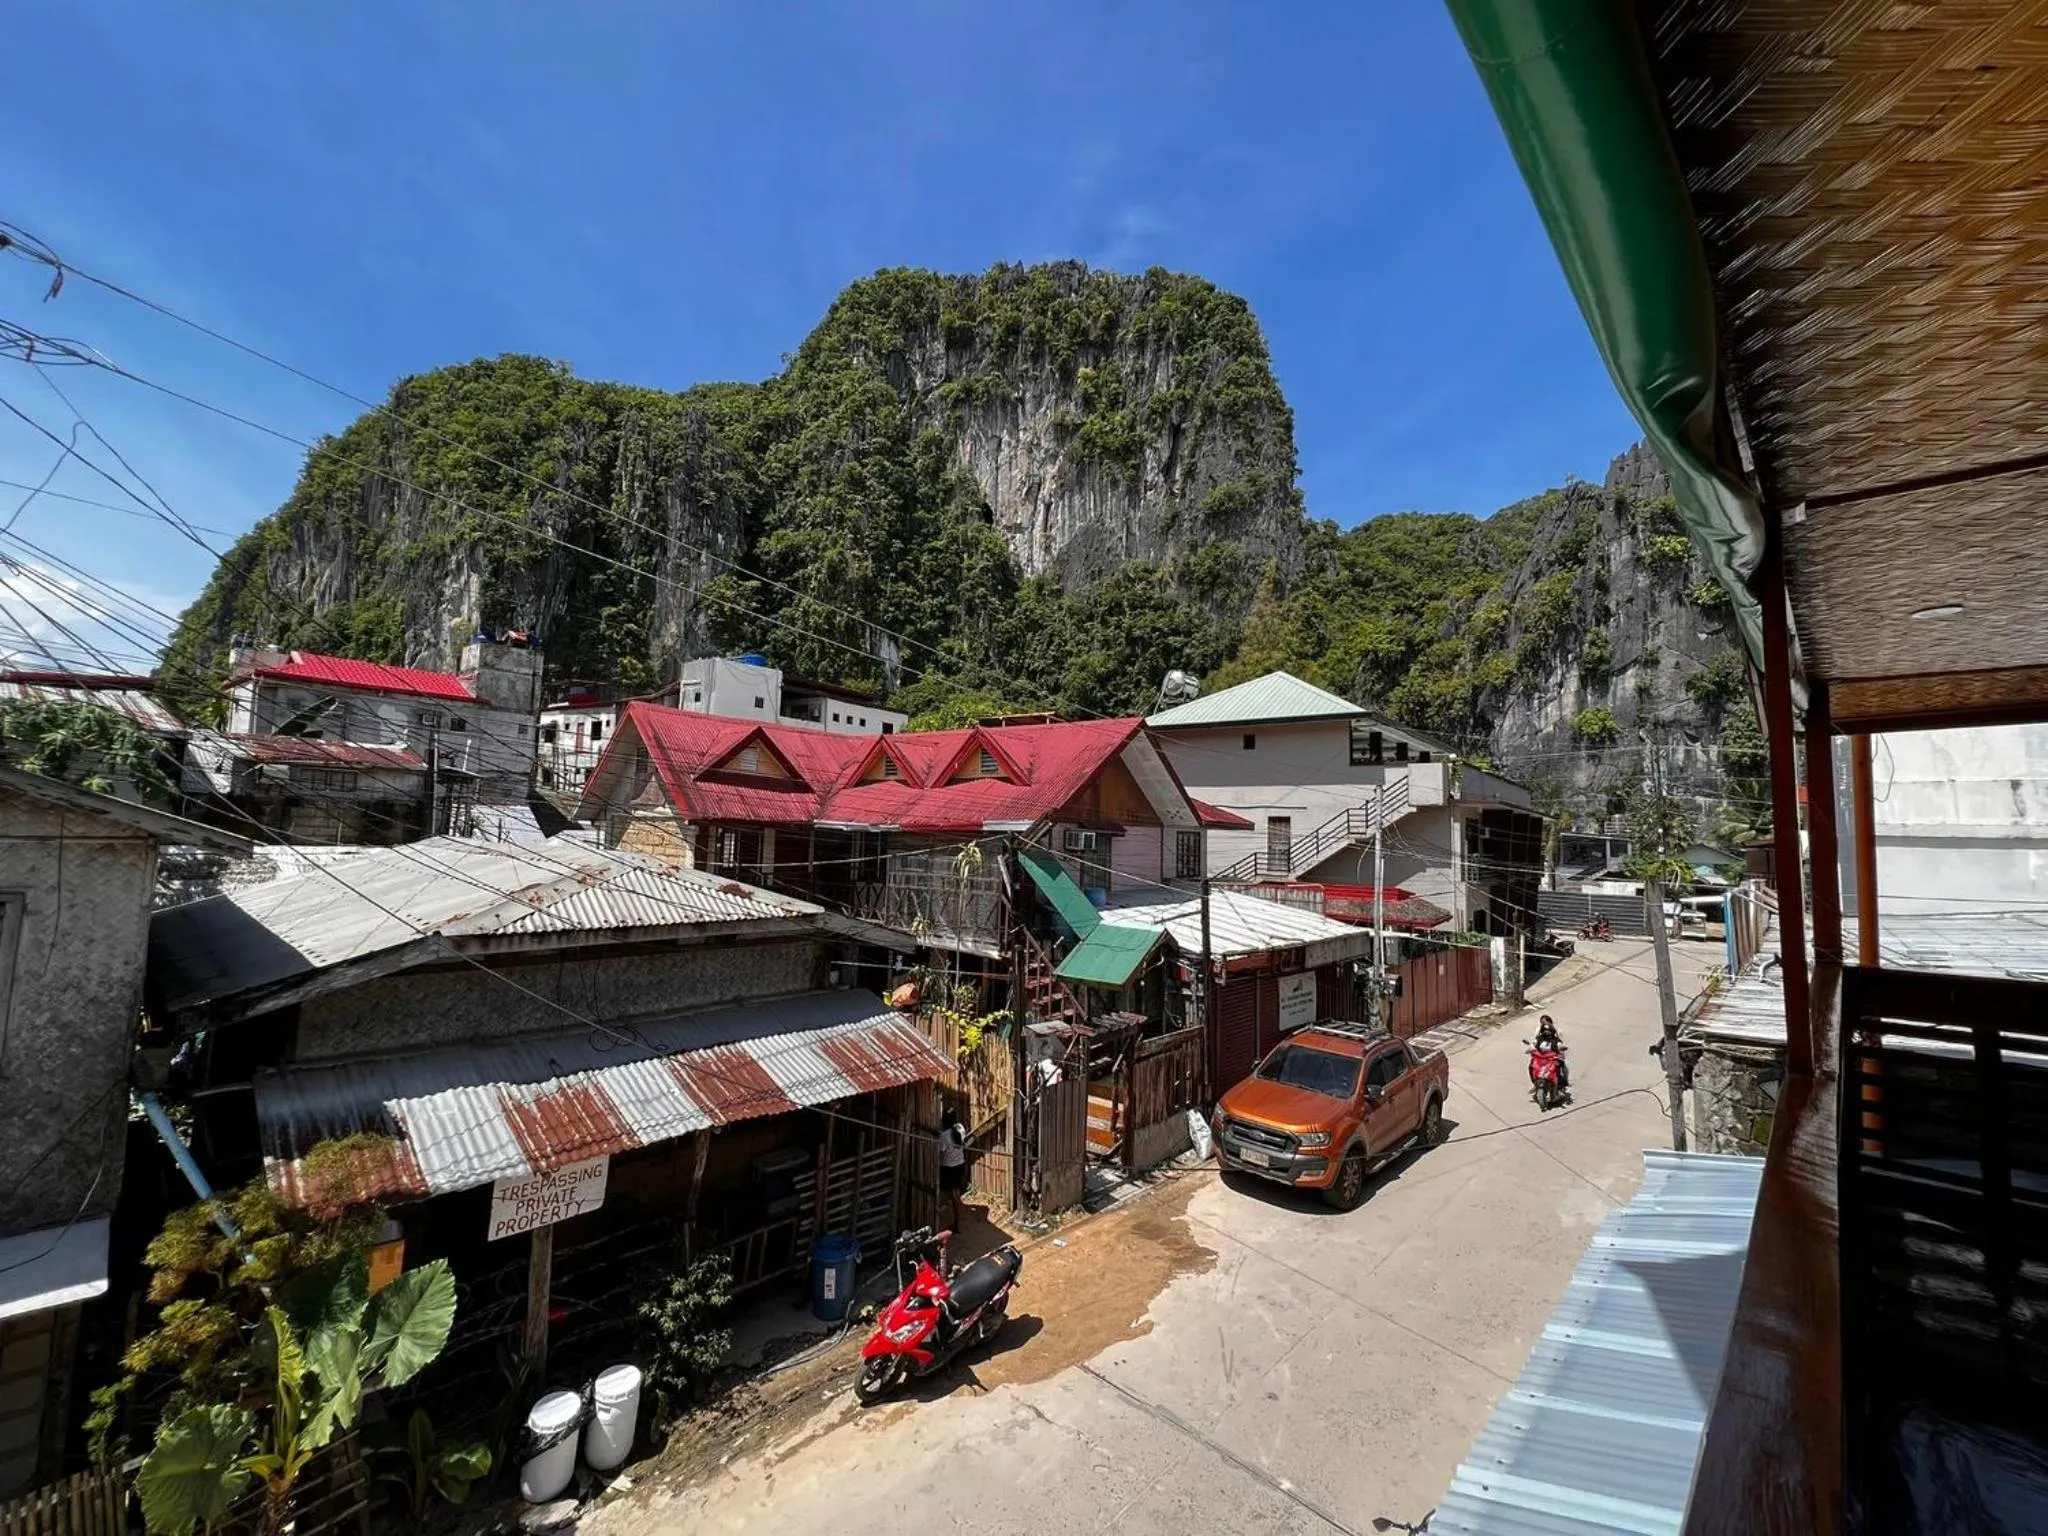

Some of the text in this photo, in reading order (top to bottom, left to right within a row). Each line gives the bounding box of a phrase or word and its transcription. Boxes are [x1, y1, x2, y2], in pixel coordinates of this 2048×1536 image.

[500, 1164, 602, 1203] TRESPASSING
[515, 1186, 577, 1216] PRIVATE
[495, 1198, 585, 1237] PROPERTY
